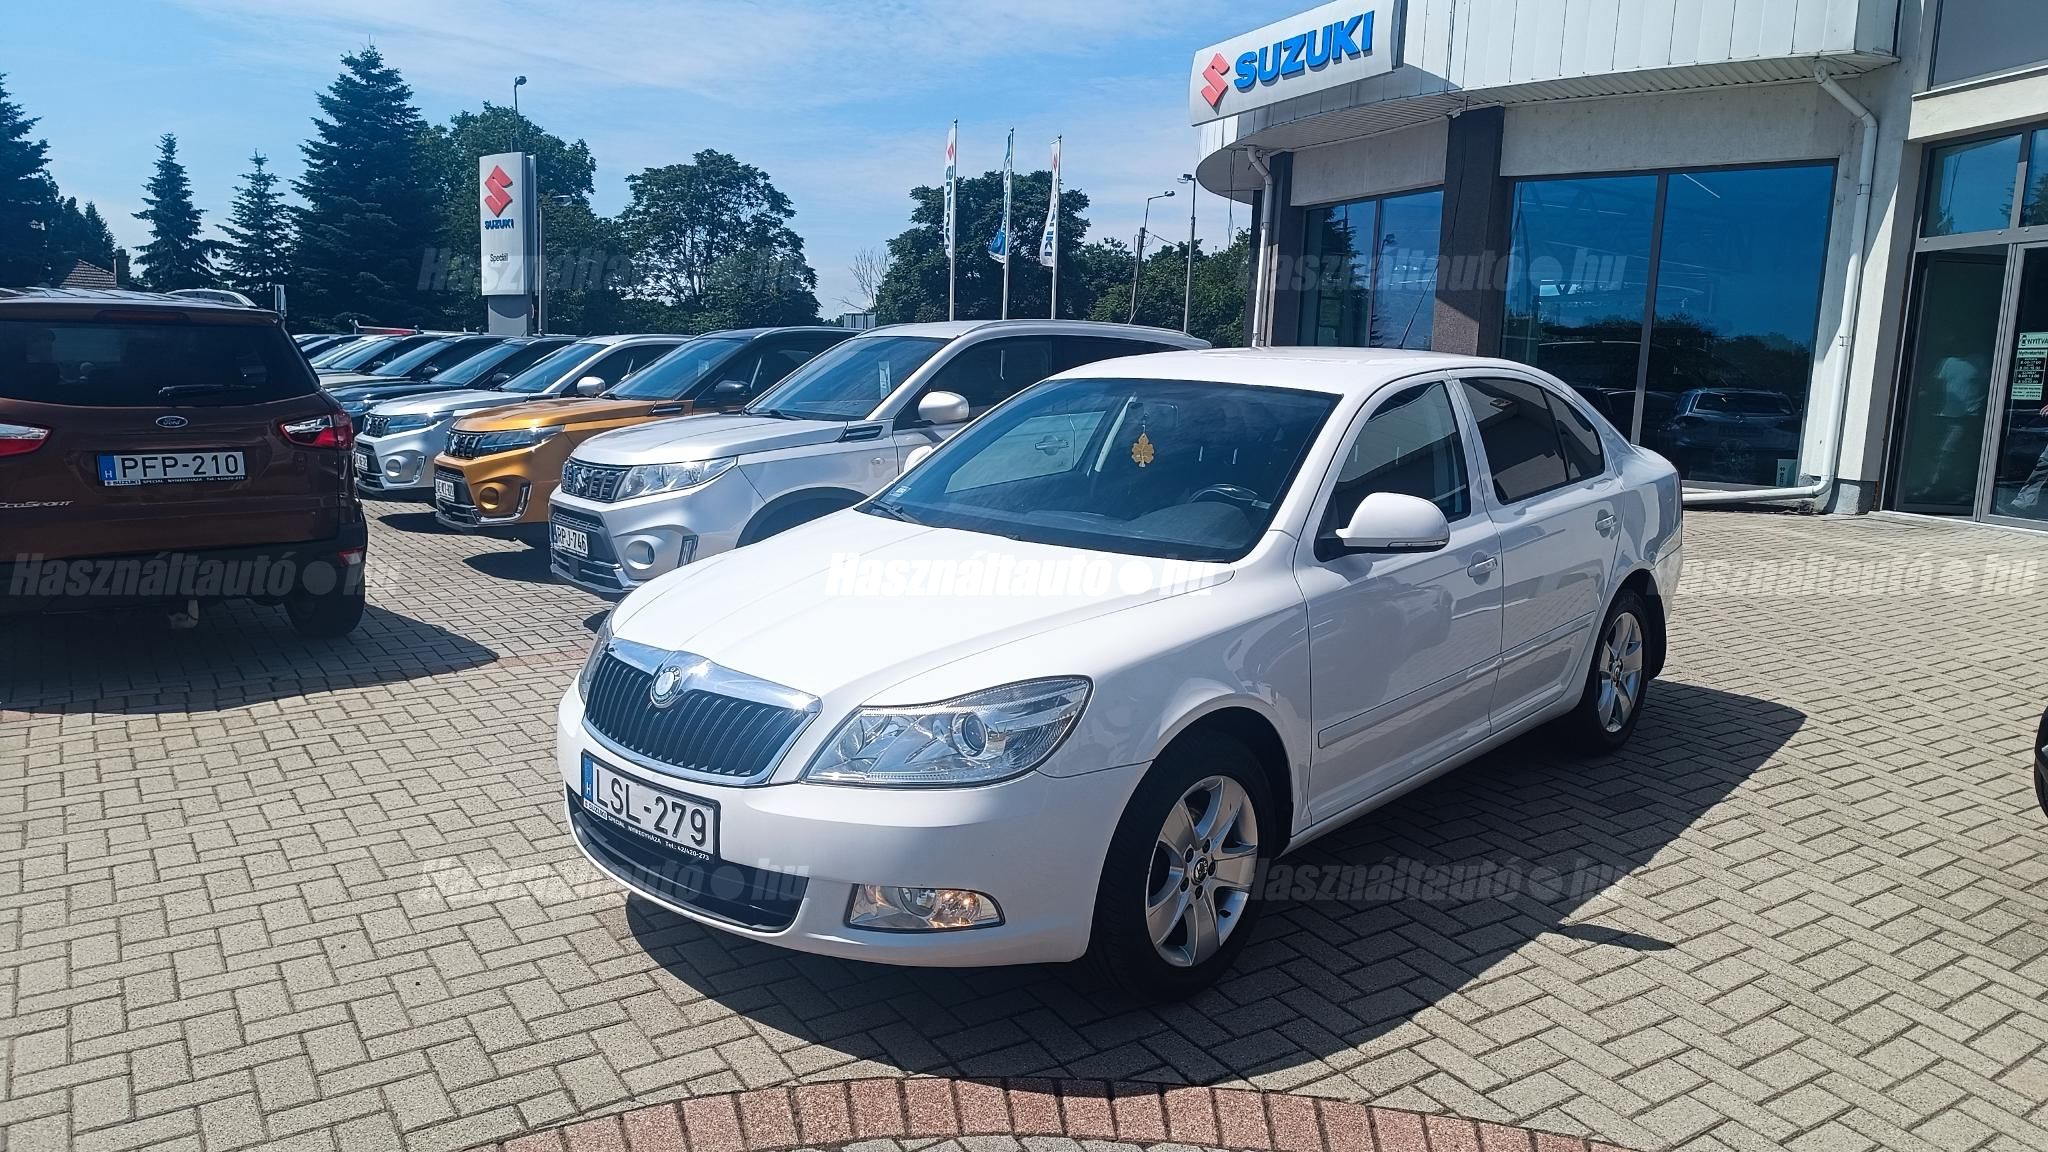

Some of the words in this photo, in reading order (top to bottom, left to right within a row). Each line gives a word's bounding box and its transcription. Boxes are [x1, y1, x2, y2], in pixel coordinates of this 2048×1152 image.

[1234, 10, 1374, 90] SUZUKI
[484, 218, 514, 230] SUZUKI
[120, 454, 239, 479] PFP-210
[586, 782, 593, 796] H
[596, 769, 707, 847] LSL-279
[677, 845, 710, 861] 42/420-273
